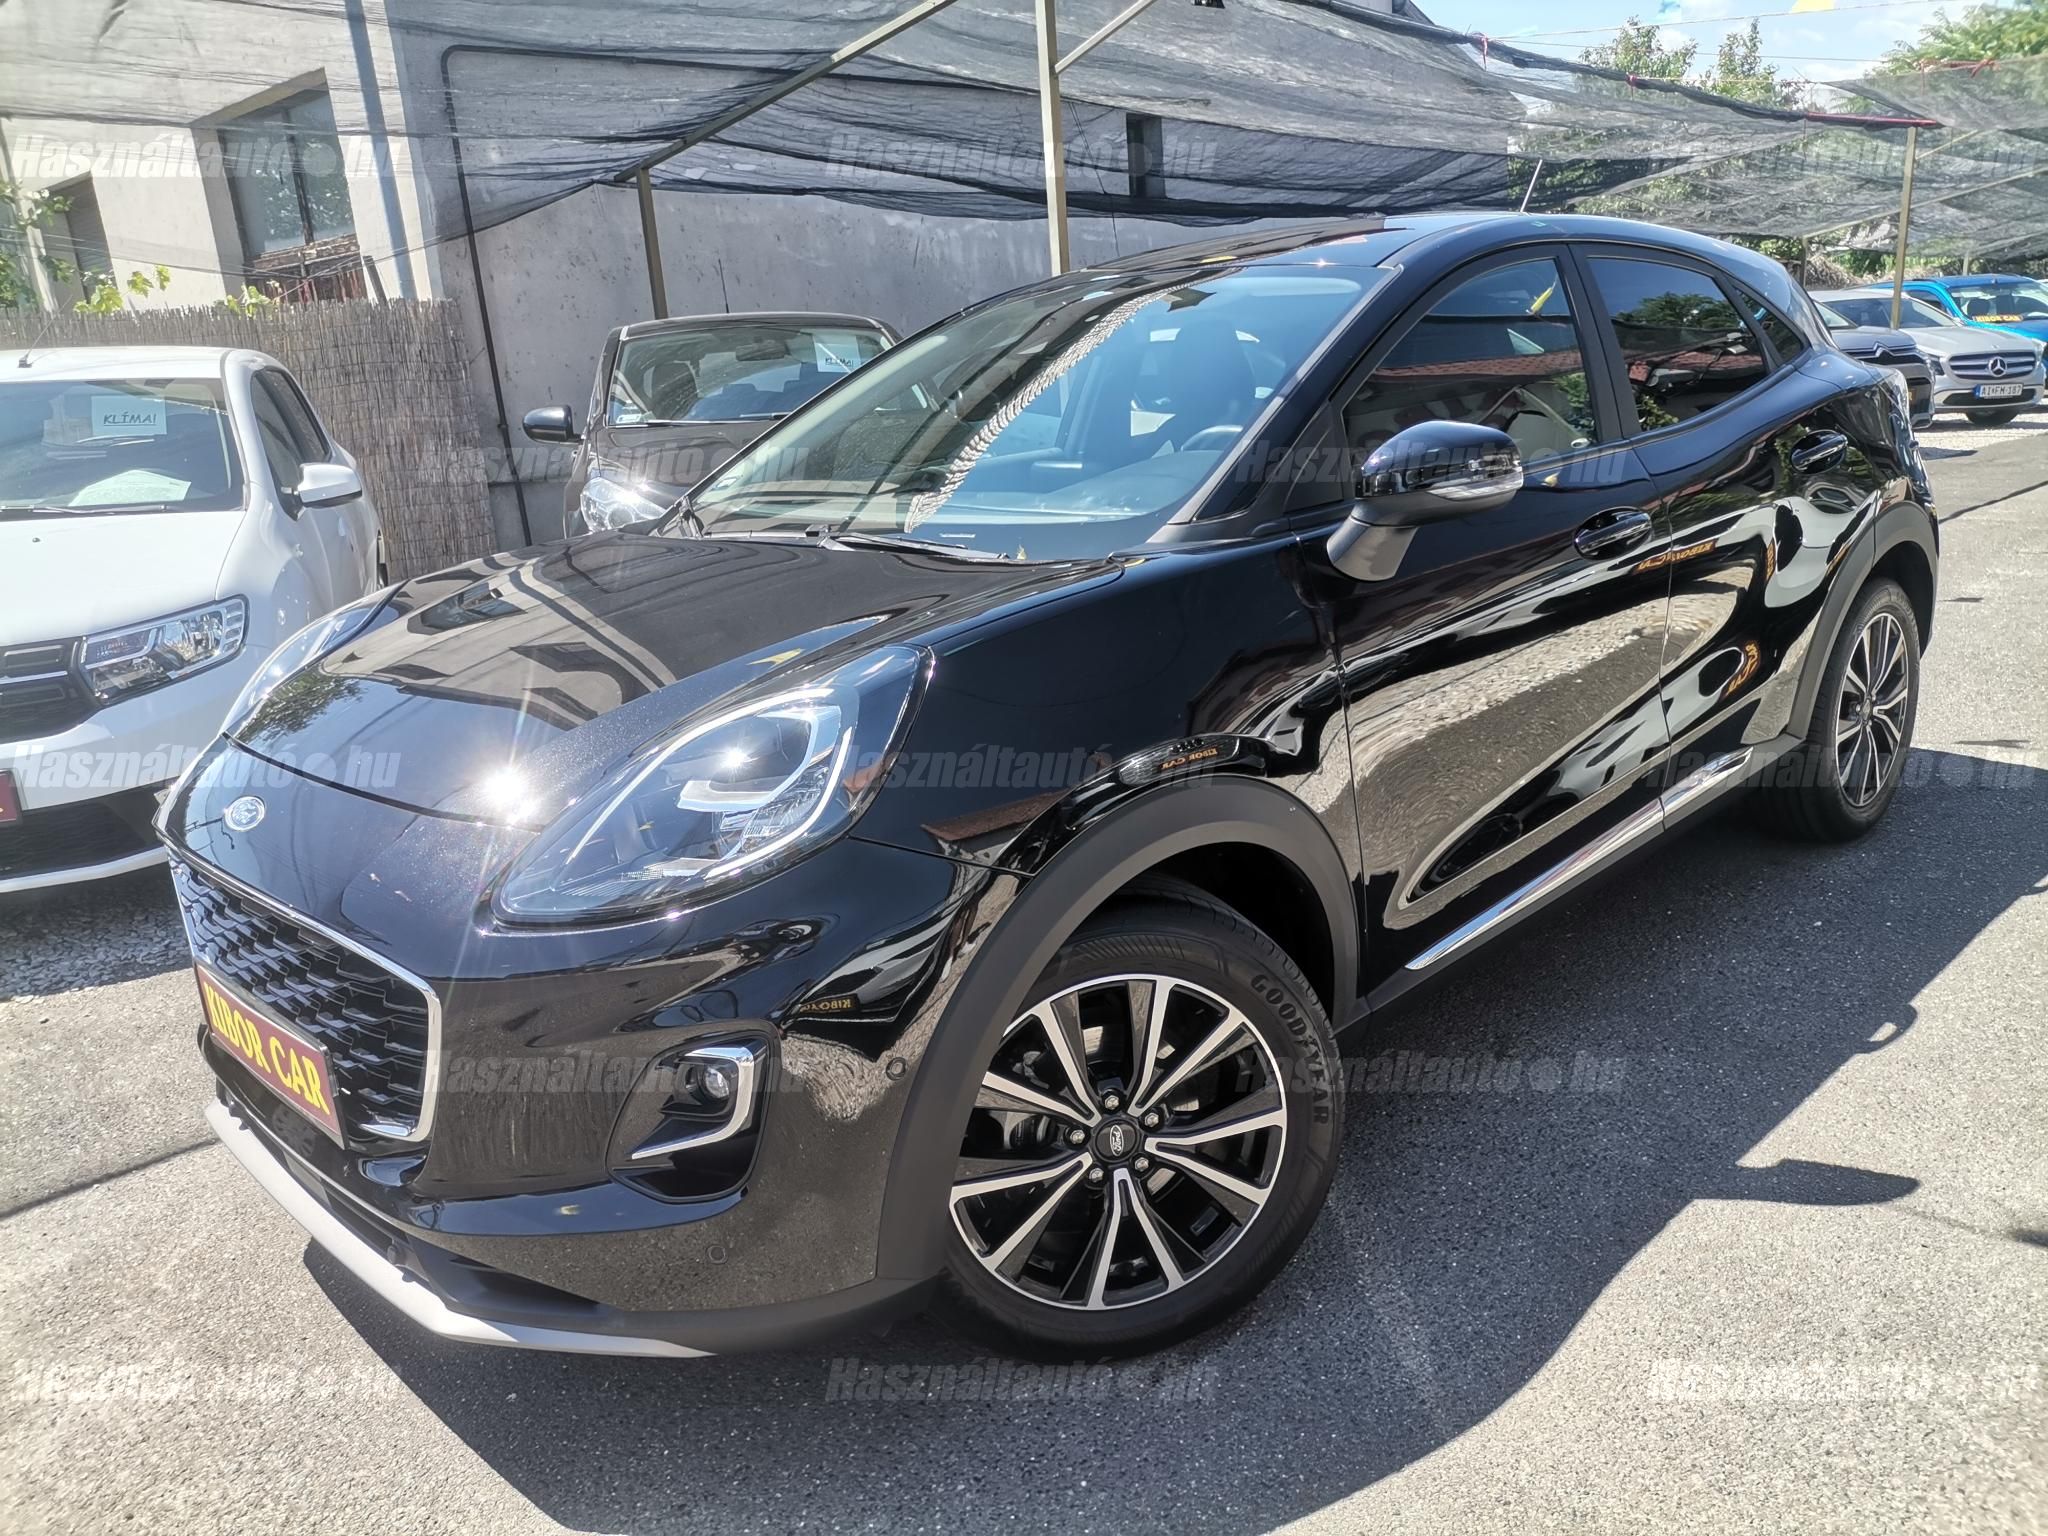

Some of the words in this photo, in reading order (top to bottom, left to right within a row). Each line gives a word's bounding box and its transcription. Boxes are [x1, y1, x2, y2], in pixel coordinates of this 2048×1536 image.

[203, 981, 272, 1074] KIBOR
[269, 1036, 331, 1116] CAR
[1251, 974, 1329, 1125] GOODYEAR
